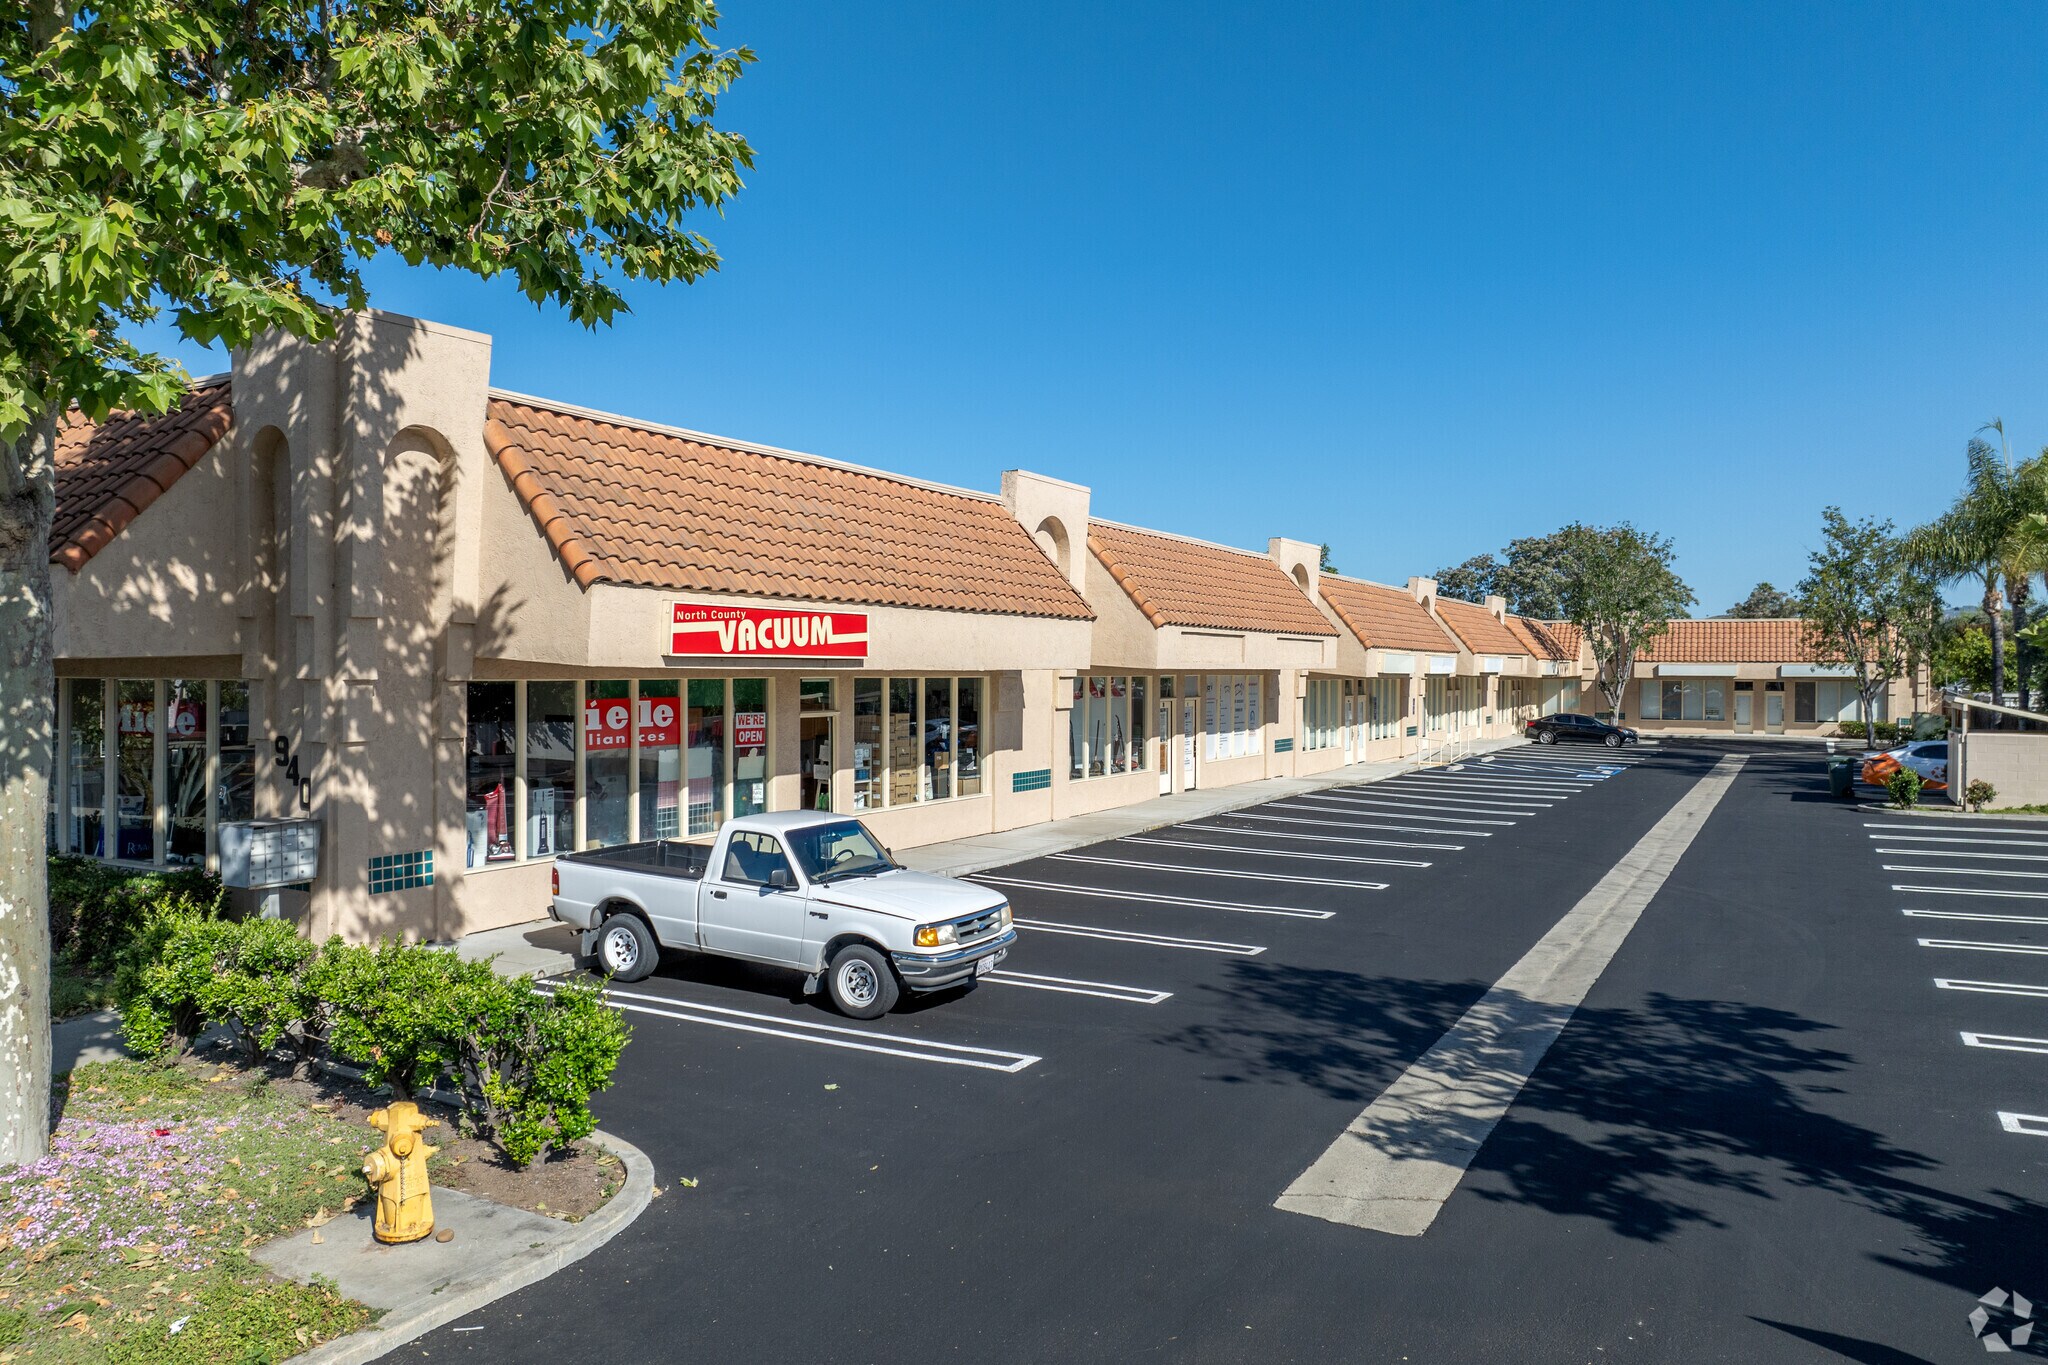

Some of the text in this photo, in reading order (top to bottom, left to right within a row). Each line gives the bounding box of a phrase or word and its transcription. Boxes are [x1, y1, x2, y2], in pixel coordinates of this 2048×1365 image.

[677, 610, 746, 620] North County
[718, 615, 834, 653] VACUUM
[586, 700, 674, 730] iele
[738, 714, 764, 725] WE'RE
[589, 732, 666, 746] liances
[738, 731, 763, 742] OPEN
[275, 735, 311, 811] 940
